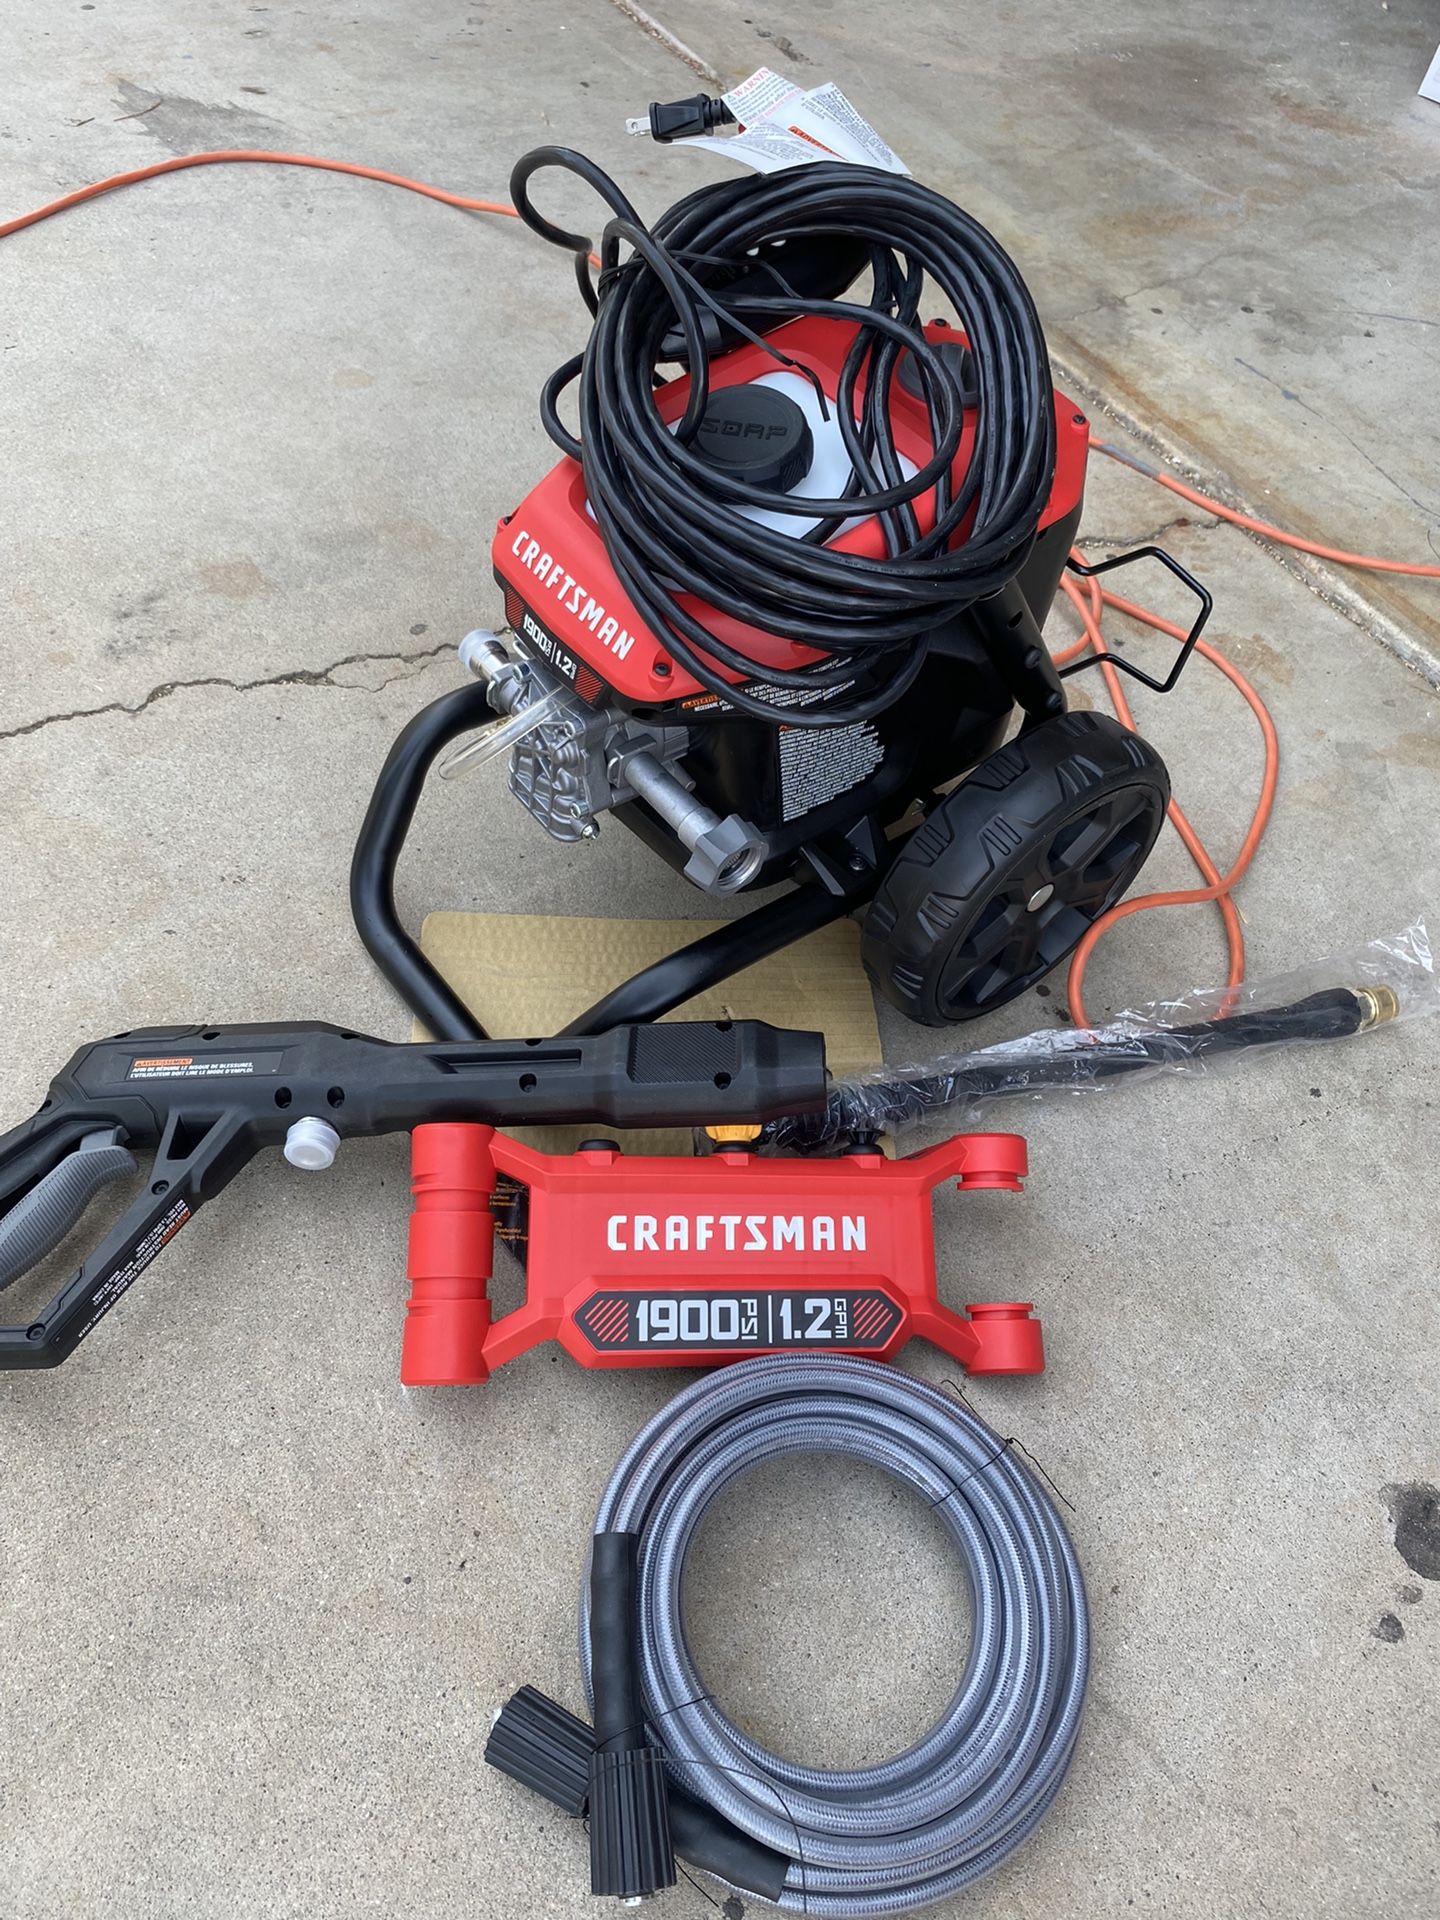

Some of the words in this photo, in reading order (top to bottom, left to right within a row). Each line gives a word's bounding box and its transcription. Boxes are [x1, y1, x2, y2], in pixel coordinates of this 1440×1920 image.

[699, 417, 788, 440] SOAP
[511, 530, 635, 661] CRAFTSMAN
[523, 613, 548, 652] 1900
[555, 650, 572, 676] 1.2
[607, 1215, 867, 1251] CRAFTSMAN
[116, 1282, 128, 1293] RISK
[127, 1272, 136, 1281] THE
[78, 1323, 92, 1337] USER
[635, 1299, 740, 1342] 1900
[740, 1299, 758, 1340] PSI
[779, 1298, 832, 1340] 1.2
[834, 1298, 848, 1339] GPM
